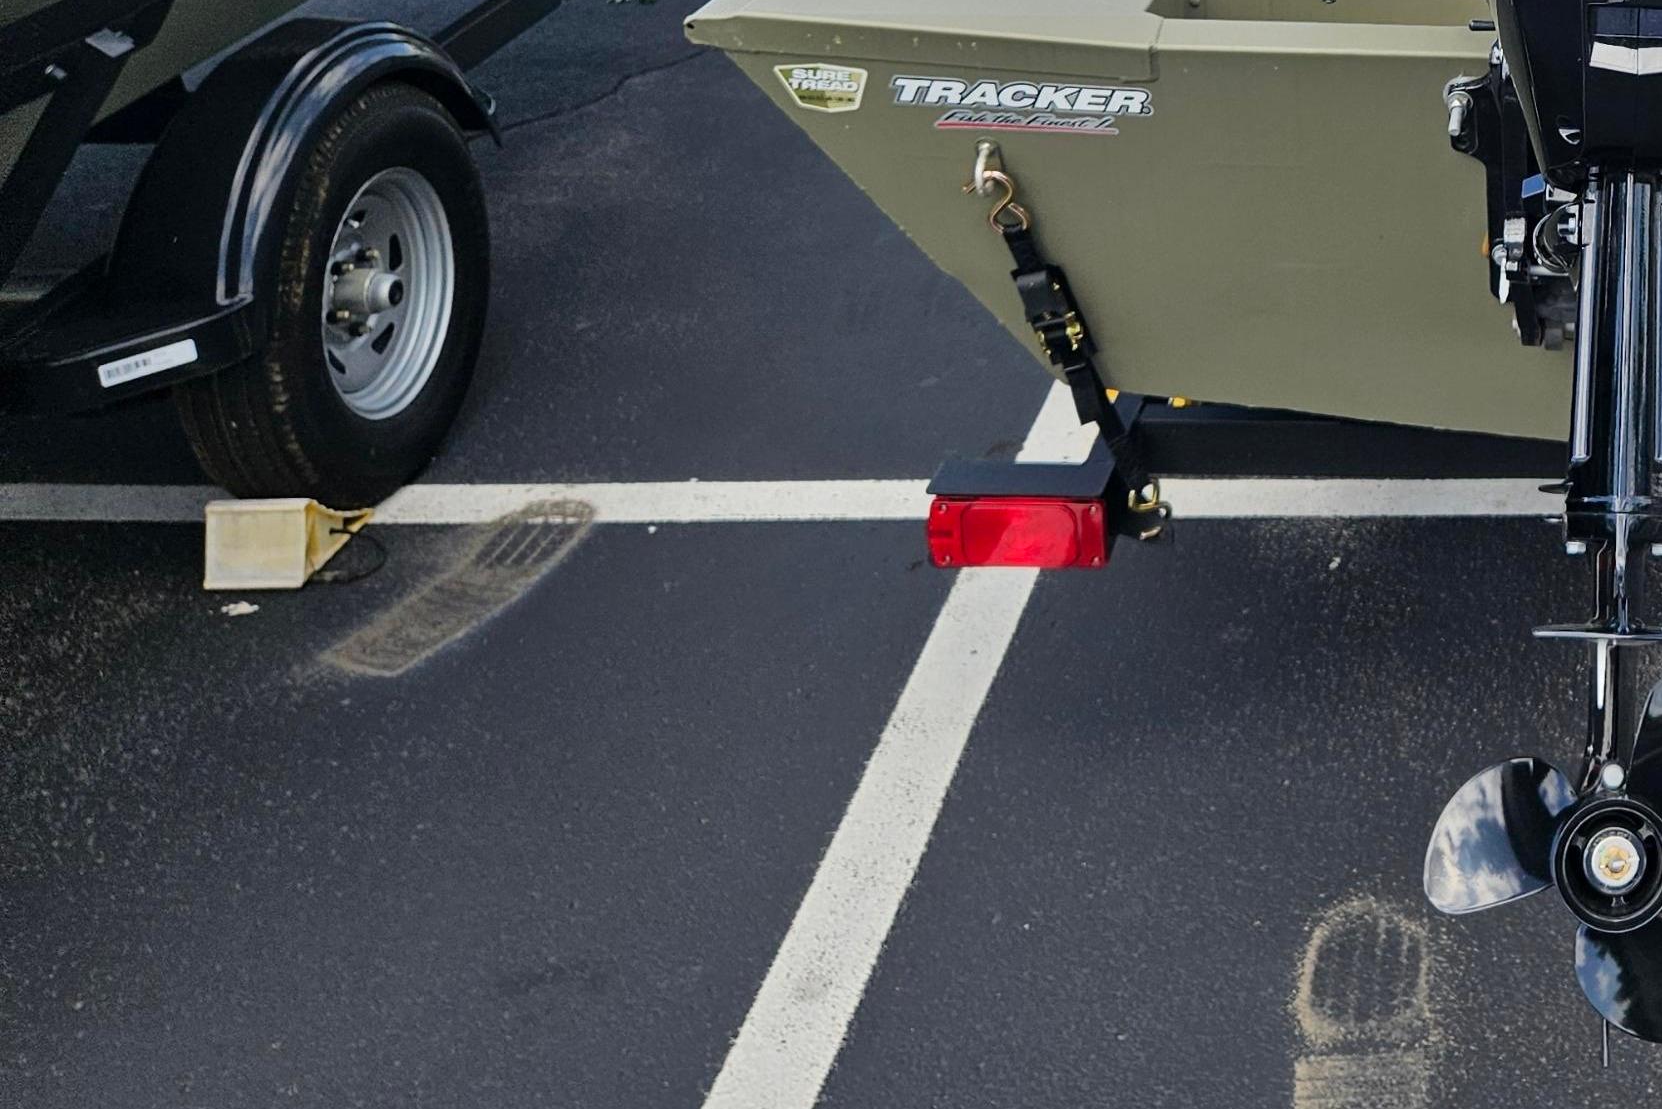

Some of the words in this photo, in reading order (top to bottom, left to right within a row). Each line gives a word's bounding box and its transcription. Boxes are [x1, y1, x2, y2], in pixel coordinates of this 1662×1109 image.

[792, 68, 850, 81] SURE
[788, 78, 859, 93] TREAD
[992, 113, 1022, 125] the
